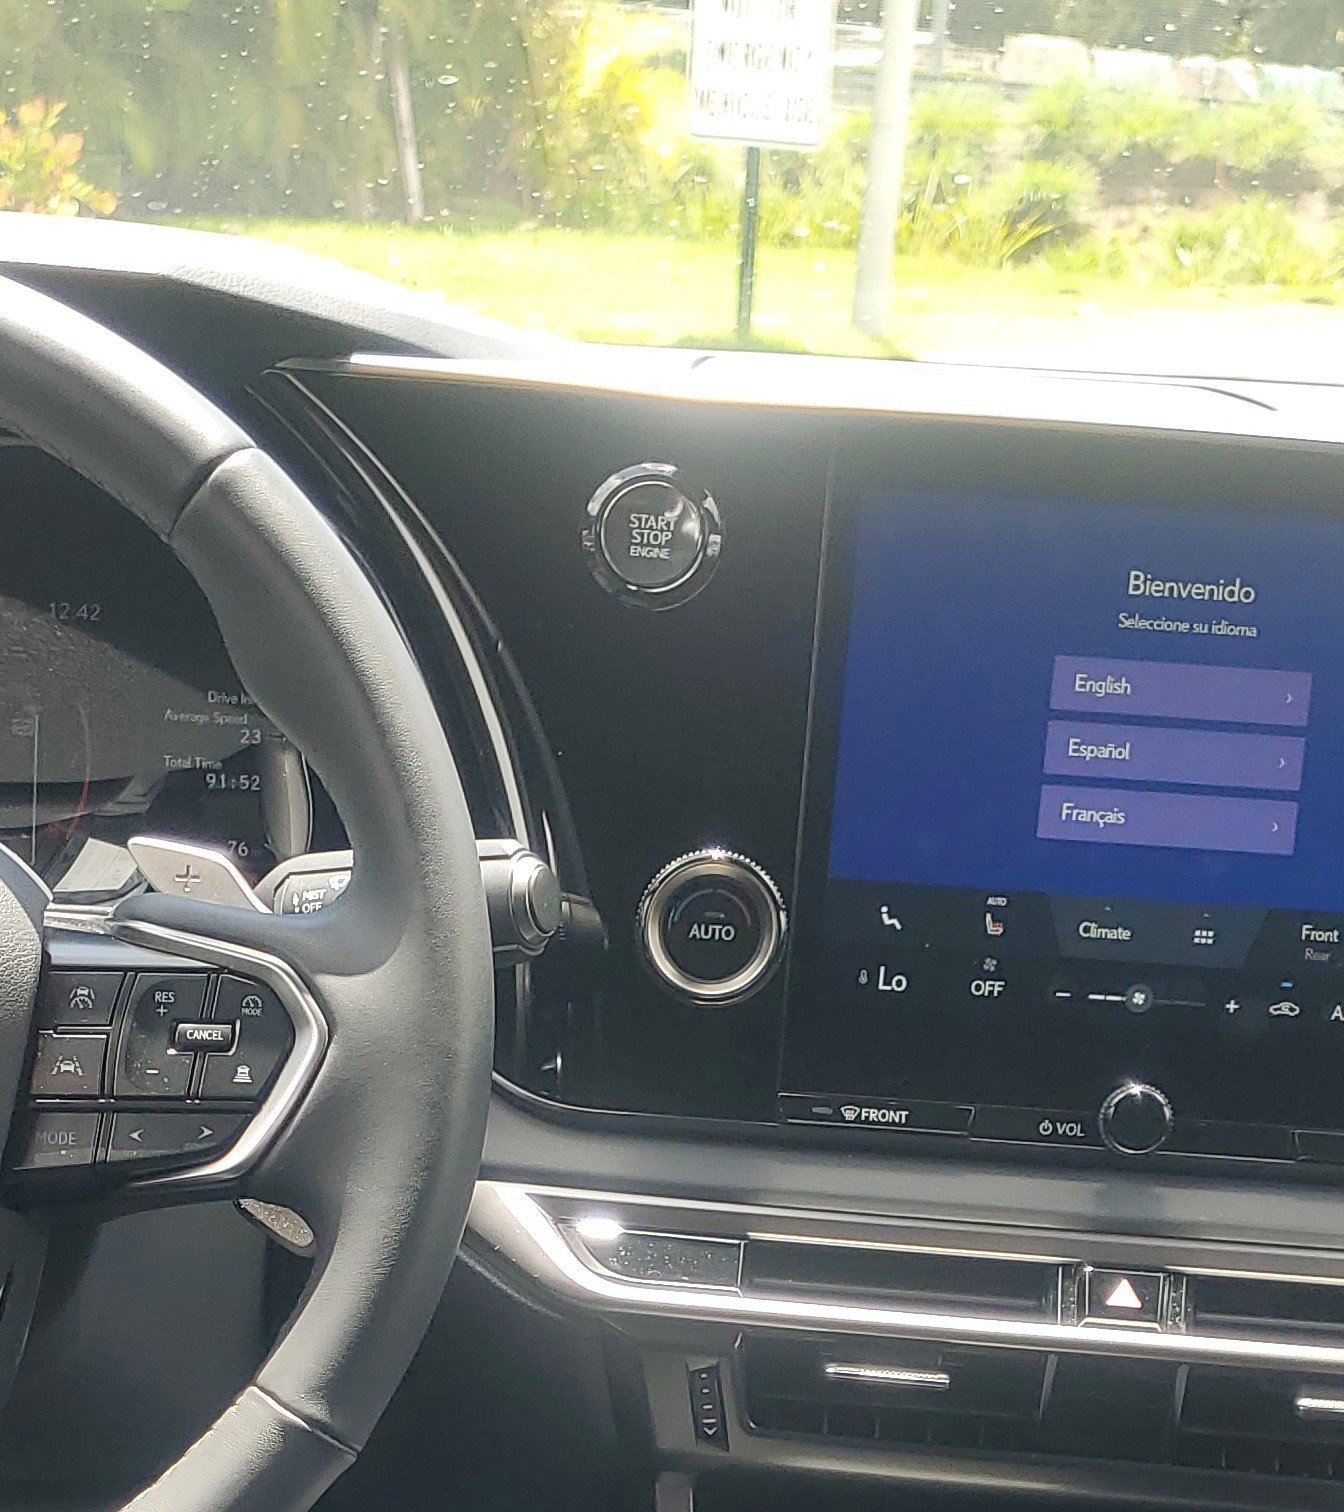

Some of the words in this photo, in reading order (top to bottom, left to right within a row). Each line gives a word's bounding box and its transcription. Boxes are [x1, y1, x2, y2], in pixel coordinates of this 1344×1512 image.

[629, 514, 678, 531] START
[631, 529, 672, 546] STOP
[629, 546, 670, 560] ENGINE
[1127, 570, 1256, 604] Bienvenido
[1117, 613, 1190, 634] Seleccione
[1192, 622, 1208, 635] su
[1211, 618, 1258, 638] idioma
[1074, 674, 1131, 698] English
[207, 690, 237, 705] Drive
[163, 709, 210, 726] Average
[239, 729, 261, 744] 23
[1067, 738, 1130, 764] Español
[163, 755, 191, 769] Total
[194, 756, 223, 770] Time
[206, 773, 261, 791] 91:52
[1061, 803, 1126, 828] Français
[227, 840, 250, 857] 76
[302, 889, 327, 901] MIST
[986, 896, 1008, 907] AUTO
[301, 901, 323, 914] OFF
[688, 922, 735, 943] AUTO
[1078, 921, 1132, 942] Climate
[1301, 924, 1340, 943] Front
[877, 965, 907, 993] Lo
[970, 979, 1006, 998] OFF
[154, 991, 175, 1004] RES
[241, 1008, 263, 1016] MODE
[186, 1029, 224, 1041] CANCEL
[861, 1106, 909, 1125] FRONT
[1055, 1121, 1086, 1138] VOL
[35, 1131, 77, 1146] MODE
